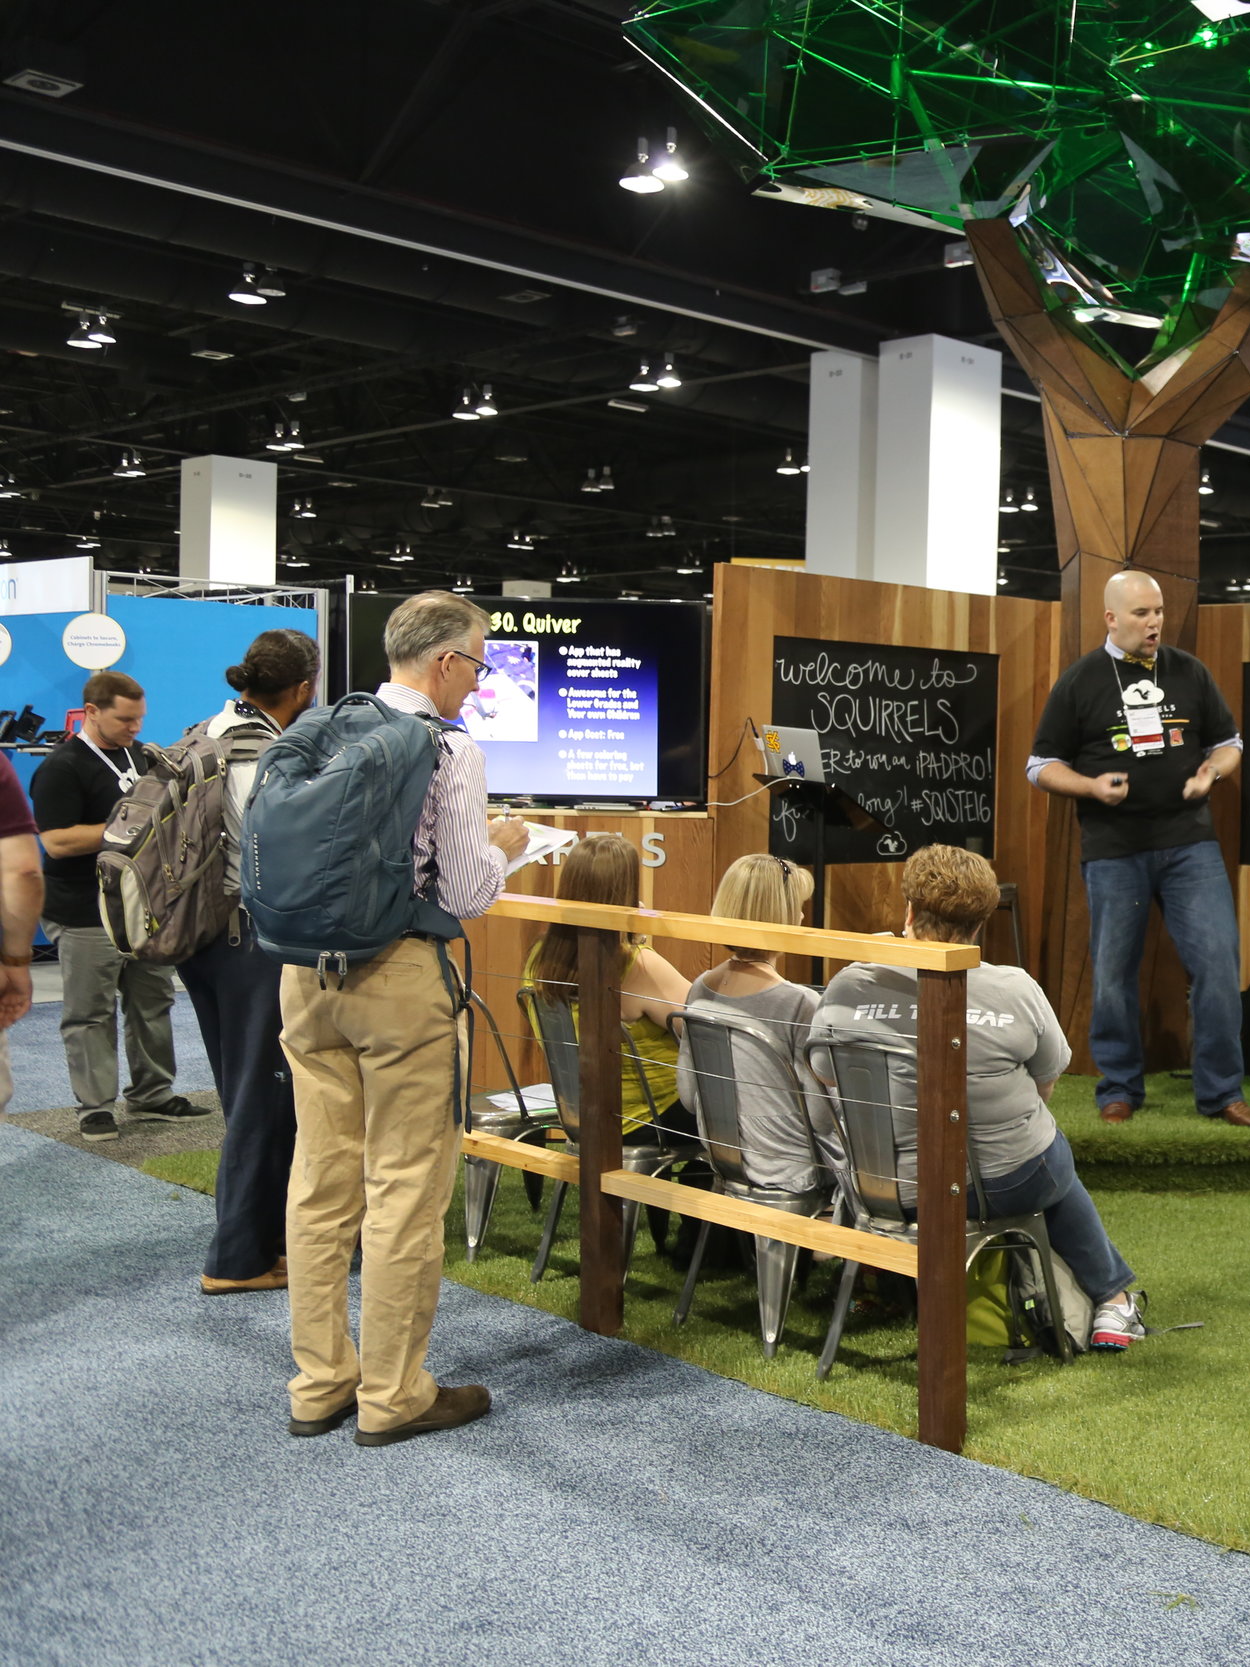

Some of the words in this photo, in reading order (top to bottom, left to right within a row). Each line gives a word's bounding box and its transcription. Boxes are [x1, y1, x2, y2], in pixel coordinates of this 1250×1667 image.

[490, 611, 518, 632] 30.
[522, 612, 582, 634] Quiver
[568, 645, 585, 658] App
[585, 645, 605, 657] that
[605, 646, 621, 657] has
[775, 652, 915, 690] welcome
[920, 658, 977, 690] to
[811, 692, 959, 744] SQUIRRELS
[843, 750, 865, 769] to
[853, 1004, 902, 1020] FILL
[966, 1009, 1015, 1028] GAP
